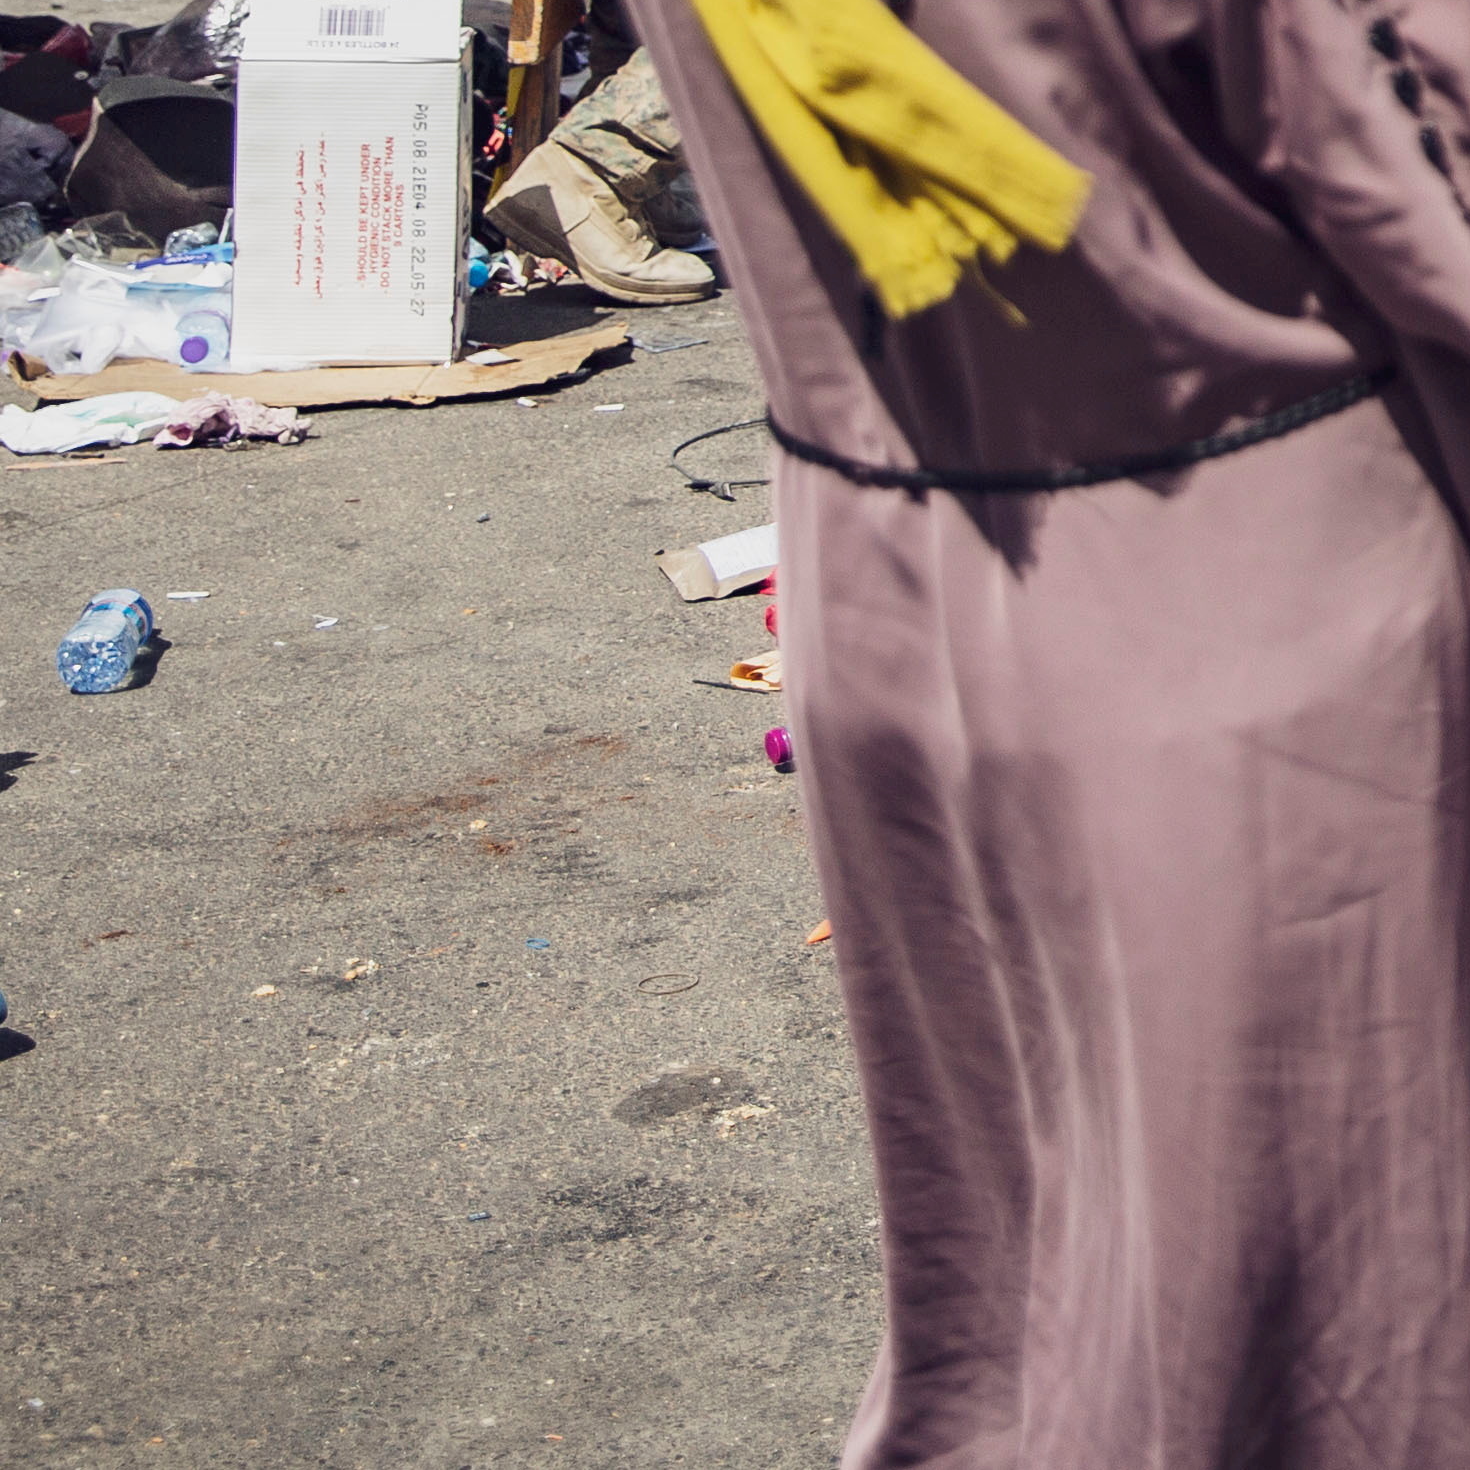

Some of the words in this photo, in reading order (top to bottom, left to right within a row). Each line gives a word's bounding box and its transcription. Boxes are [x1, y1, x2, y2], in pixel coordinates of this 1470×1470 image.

[360, 144, 371, 181] UNDER
[385, 136, 394, 166] THAN
[360, 187, 369, 213] KEPT
[371, 157, 382, 218] CONDITION
[383, 171, 393, 202] MORE
[359, 219, 368, 231] BE
[382, 207, 392, 241] STACK
[394, 184, 404, 237] CARTONS
[357, 235, 367, 281] SHOULD
[370, 222, 380, 273] HYGIENIC
[381, 246, 390, 268] NOT
[381, 272, 390, 287] DO
